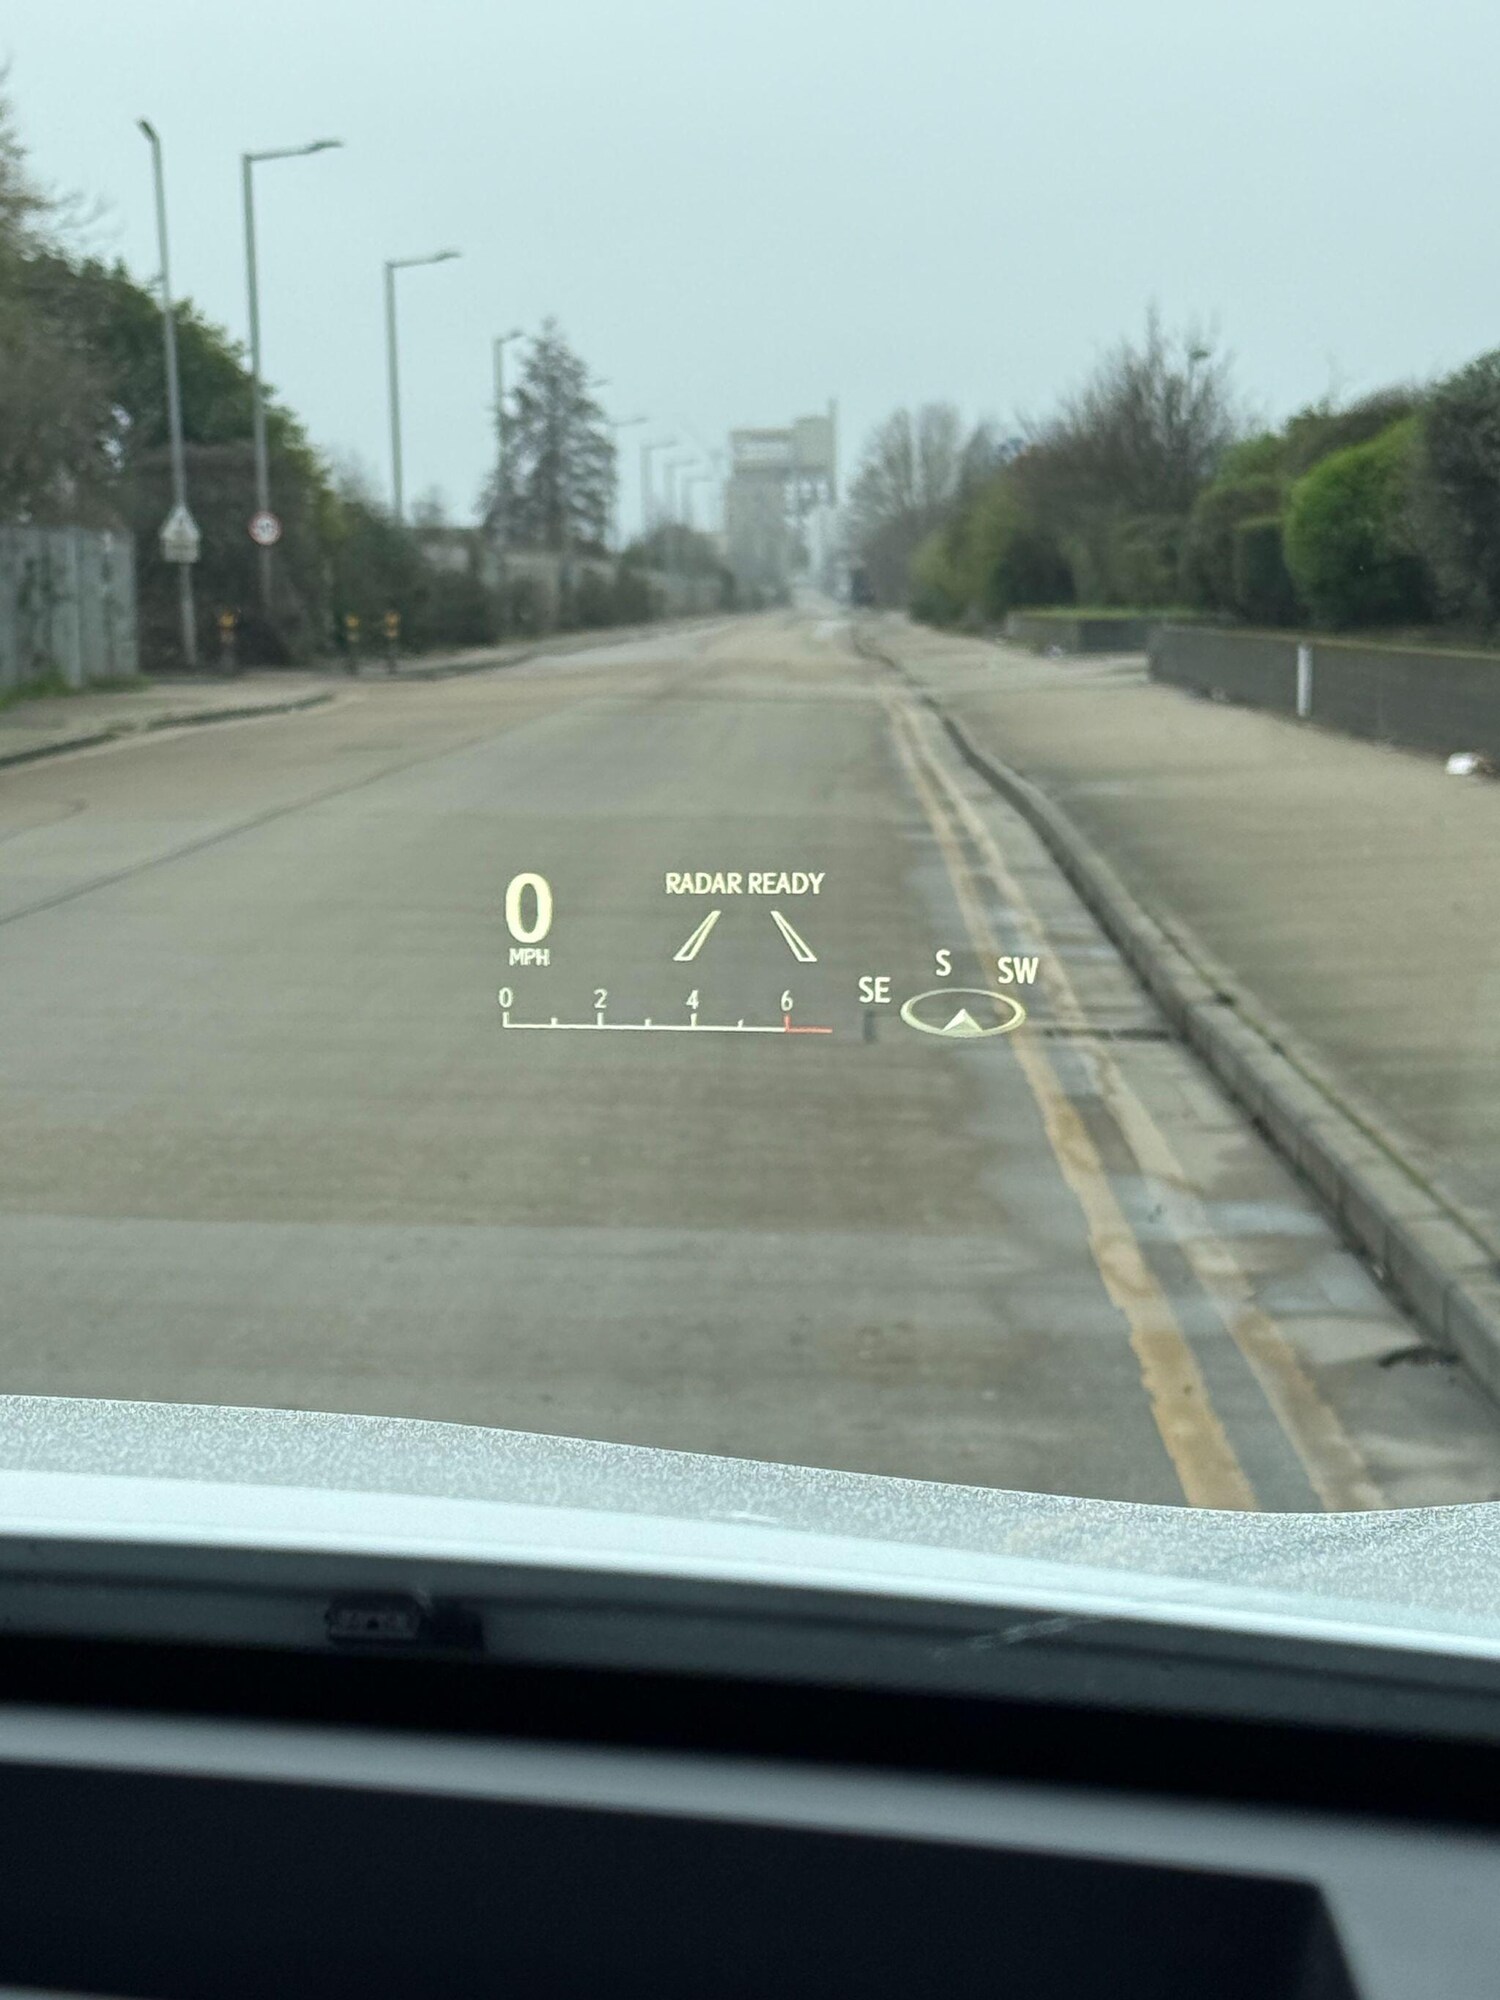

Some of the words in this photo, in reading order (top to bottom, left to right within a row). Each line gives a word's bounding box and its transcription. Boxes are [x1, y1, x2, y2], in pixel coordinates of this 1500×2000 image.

[665, 872, 743, 894] RADAR
[747, 872, 826, 894] READY
[505, 873, 553, 943] 0
[509, 947, 551, 966] MPH
[935, 948, 953, 977] S
[997, 956, 1039, 985] SW
[498, 987, 513, 1008] 0
[593, 988, 608, 1008] 2
[685, 989, 700, 1010] 4
[780, 989, 794, 1012] 6
[858, 976, 892, 1004] SE
